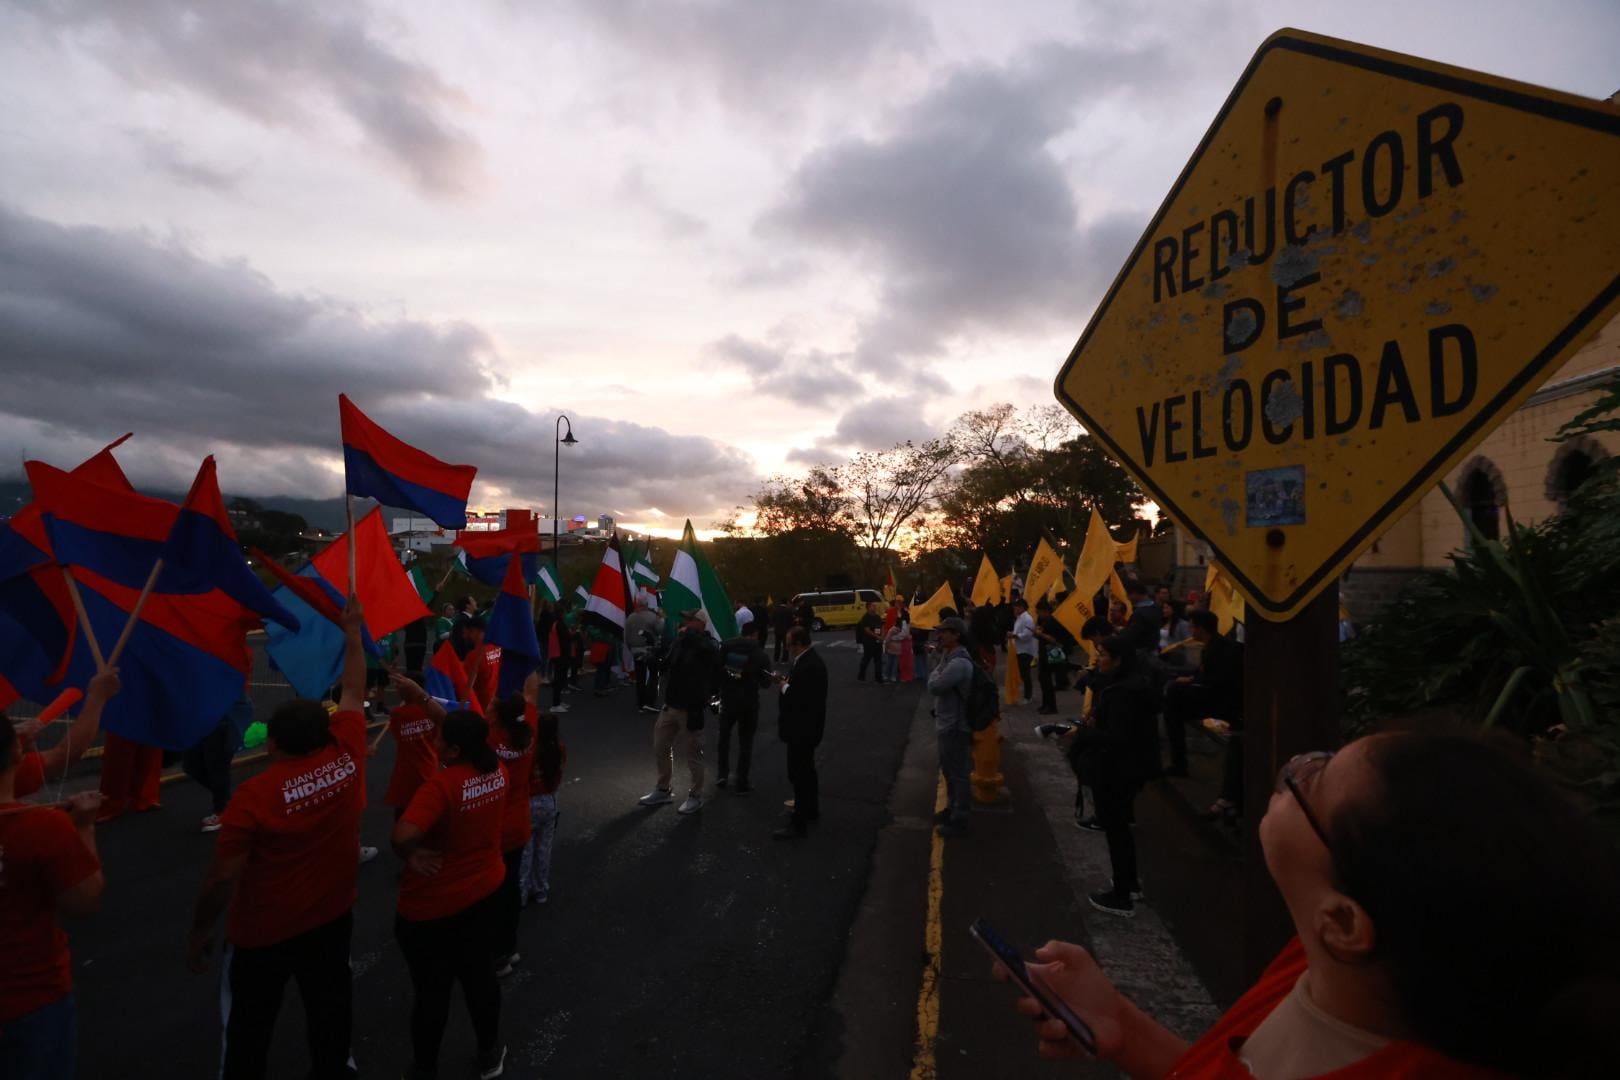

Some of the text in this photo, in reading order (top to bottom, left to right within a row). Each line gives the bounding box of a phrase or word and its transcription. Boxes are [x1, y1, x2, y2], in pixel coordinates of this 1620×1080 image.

[1152, 102, 1465, 303] REDUCTOR
[1223, 272, 1323, 355] DE
[1136, 324, 1478, 468] VELOCIDAD
[281, 752, 352, 791] JUAN CARLOS
[283, 761, 356, 804] HIDALGO
[462, 776, 481, 788] JUAN
[462, 776, 505, 802] HIDALGO
